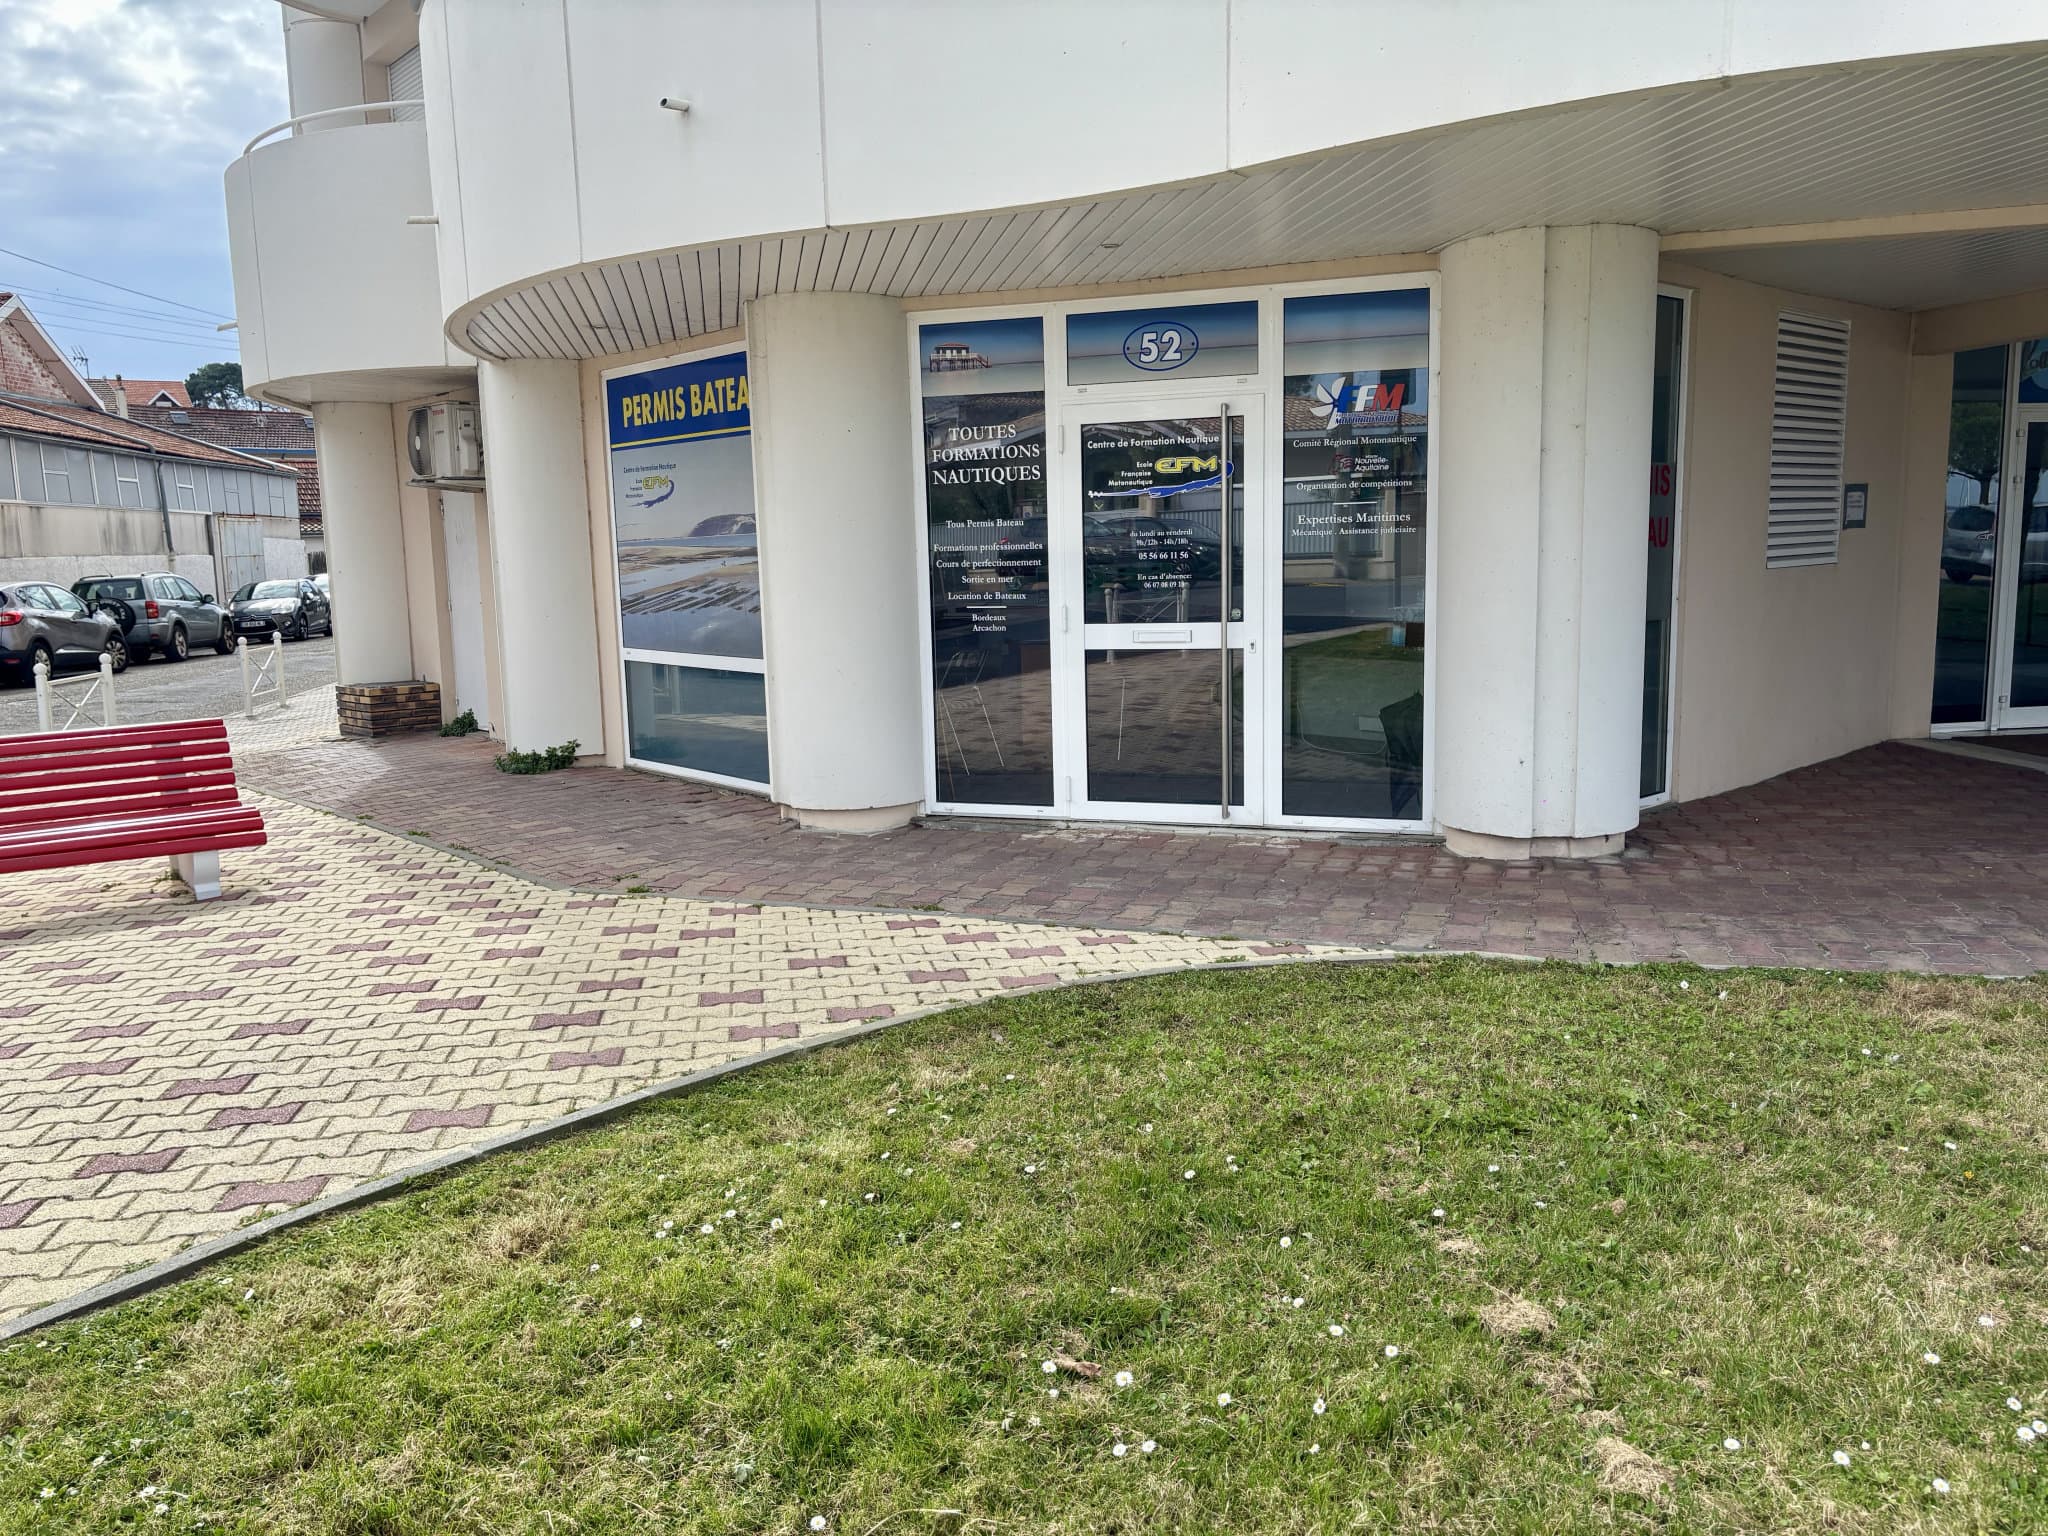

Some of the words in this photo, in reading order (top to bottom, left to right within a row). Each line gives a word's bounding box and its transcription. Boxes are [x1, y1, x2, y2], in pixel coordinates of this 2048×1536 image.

[1139, 329, 1182, 363] 52
[1337, 383, 1405, 413] FFM
[622, 386, 686, 428] PERMIS
[948, 424, 1017, 441] TOUTES
[1087, 440, 1116, 449] Centre
[1117, 439, 1128, 448] de
[1130, 437, 1176, 447] Formation
[1177, 435, 1220, 446] Nautique
[1293, 439, 1321, 448] Comité
[1324, 437, 1359, 448] Régional
[1360, 435, 1417, 446] Motonautique
[932, 443, 1040, 462] FORMATIONS
[1154, 455, 1218, 474] EFM
[1354, 464, 1390, 472] Aquitaine
[932, 465, 1041, 485] NAUTIQUES
[1121, 470, 1152, 479] Française
[1650, 464, 1671, 496] IS
[1108, 479, 1153, 488] Motonautique
[1296, 480, 1347, 492] Organisation
[1348, 480, 1358, 489] de
[1360, 478, 1413, 490] compétitions
[946, 520, 965, 529] Tous
[967, 519, 995, 528] Permis
[996, 518, 1024, 527] Bateau
[1298, 513, 1353, 527] Expertises
[1356, 512, 1411, 523] Maritimes
[1139, 529, 1156, 537] lundi
[1166, 528, 1193, 536] vendredi
[1291, 528, 1333, 538] Mécanique
[1338, 527, 1379, 535] Assistance
[1380, 526, 1417, 535] judiciaire
[933, 543, 978, 552] Formations
[980, 541, 1043, 553] professionnelles
[1138, 551, 1148, 560] 05
[1148, 551, 1158, 560] 56
[1159, 551, 1169, 560] 66
[1170, 551, 1178, 559] 11
[1179, 551, 1189, 559] 56
[935, 559, 959, 568] Cours
[960, 559, 971, 568] de
[972, 559, 1042, 570] perfectionnement
[961, 575, 985, 584] Sortie
[948, 592, 982, 600] Location
[983, 591, 993, 600] de
[995, 591, 1027, 600] Bateaux
[971, 613, 1007, 621] Bordeaux
[971, 624, 1007, 632] Arcachon
